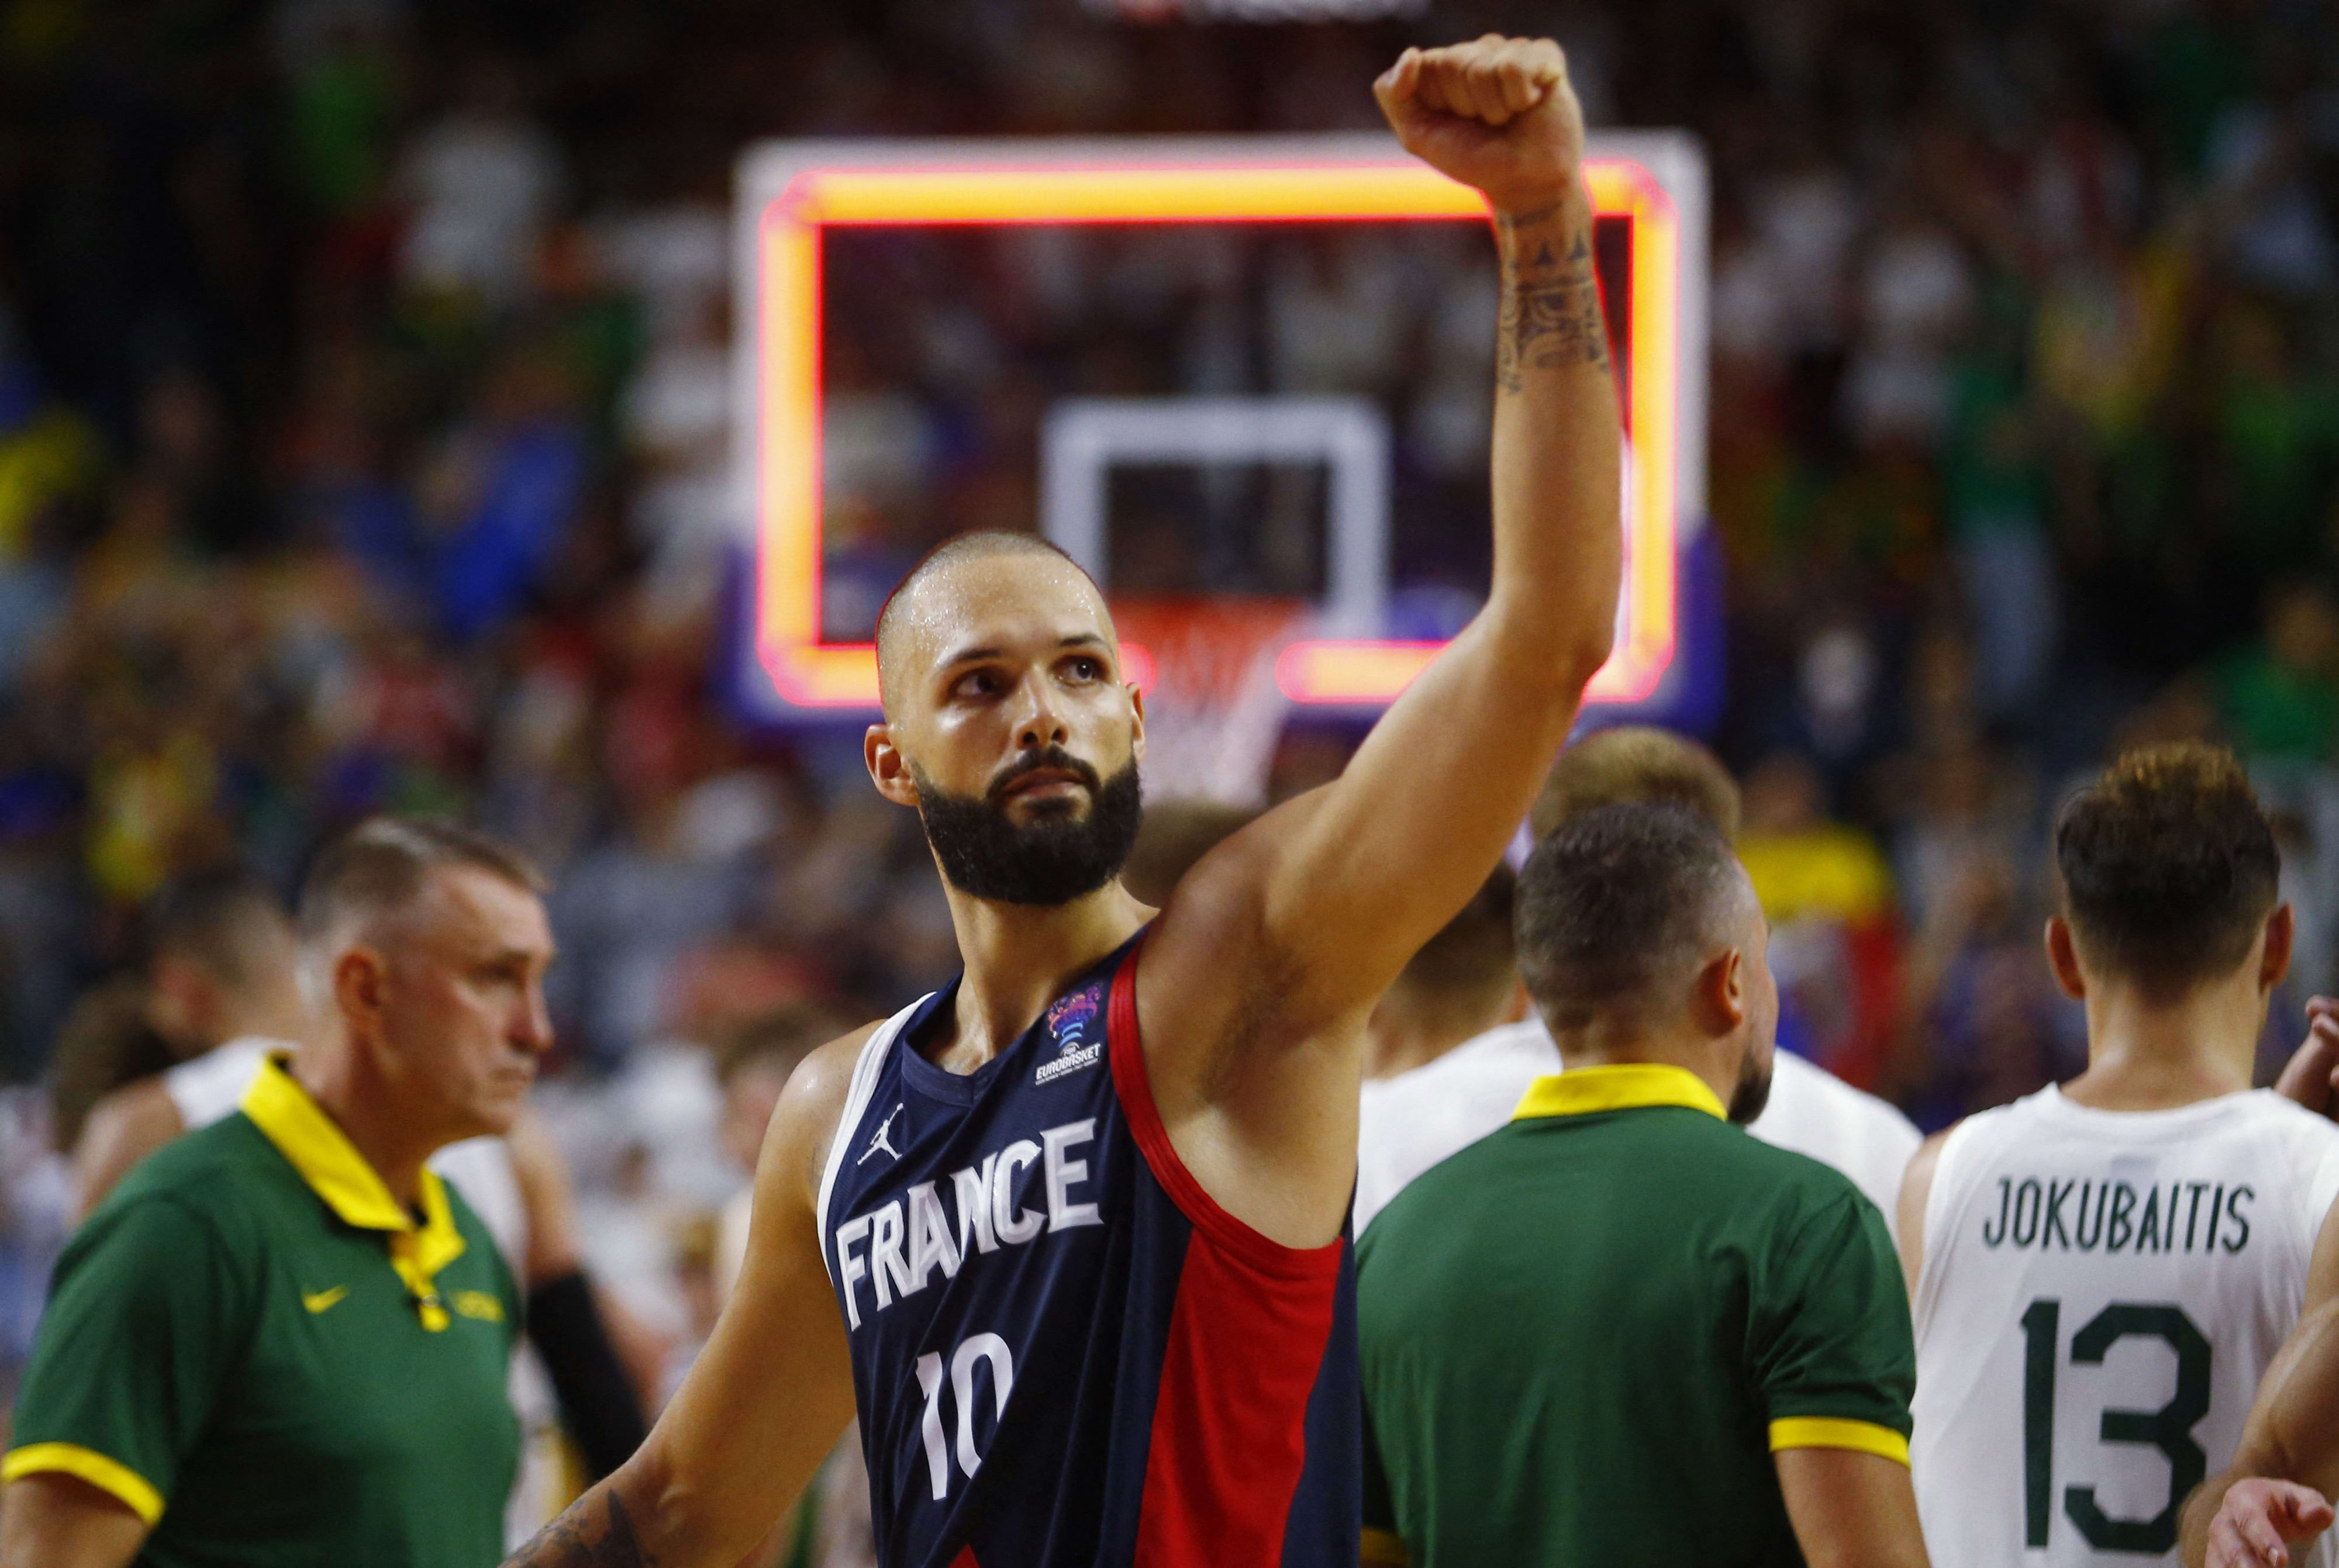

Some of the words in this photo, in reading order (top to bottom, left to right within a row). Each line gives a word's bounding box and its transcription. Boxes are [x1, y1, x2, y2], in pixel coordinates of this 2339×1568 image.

[1036, 1042, 1101, 1080] EUROBASKET
[836, 1117, 1105, 1331] FRANCE
[1983, 1174, 2255, 1256] JOKUBAITIS
[915, 1332, 1013, 1501] 10
[2019, 1296, 2213, 1556] 13
